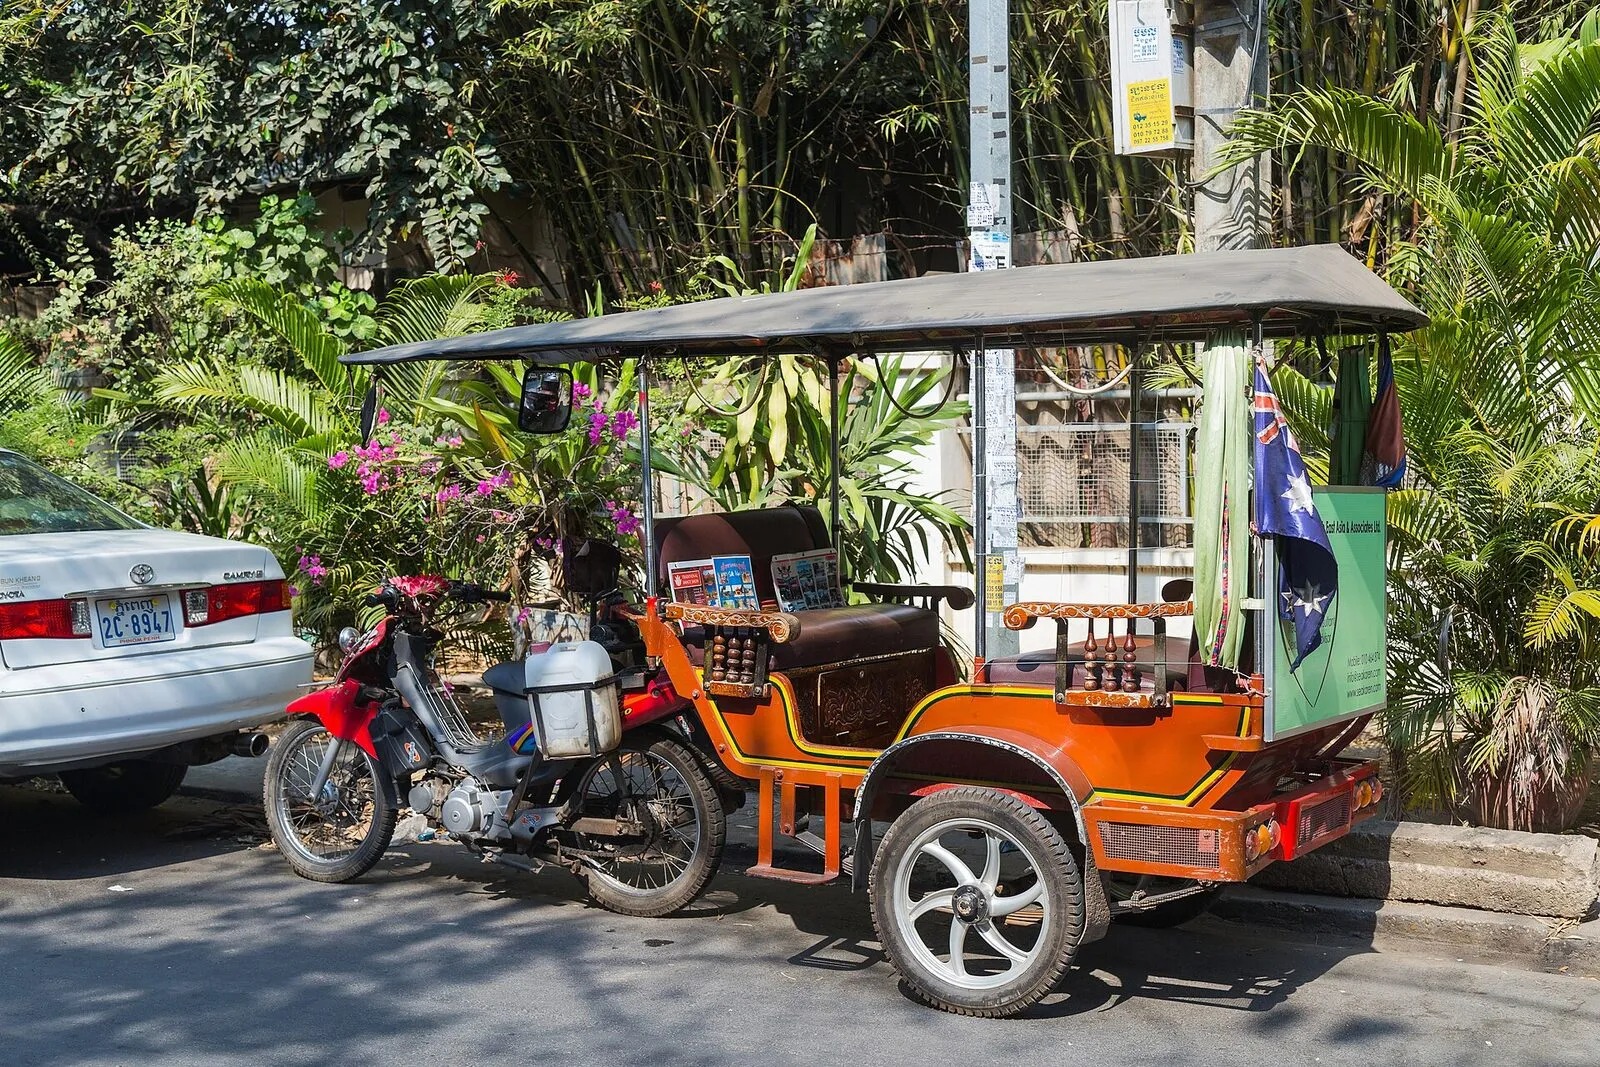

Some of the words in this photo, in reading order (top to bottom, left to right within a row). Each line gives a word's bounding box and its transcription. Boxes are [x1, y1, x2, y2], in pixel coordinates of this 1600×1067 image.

[1326, 520, 1336, 534] East
[1336, 520, 1346, 534] Asia
[1351, 520, 1373, 534] Associates
[223, 571, 255, 580] CAMRY
